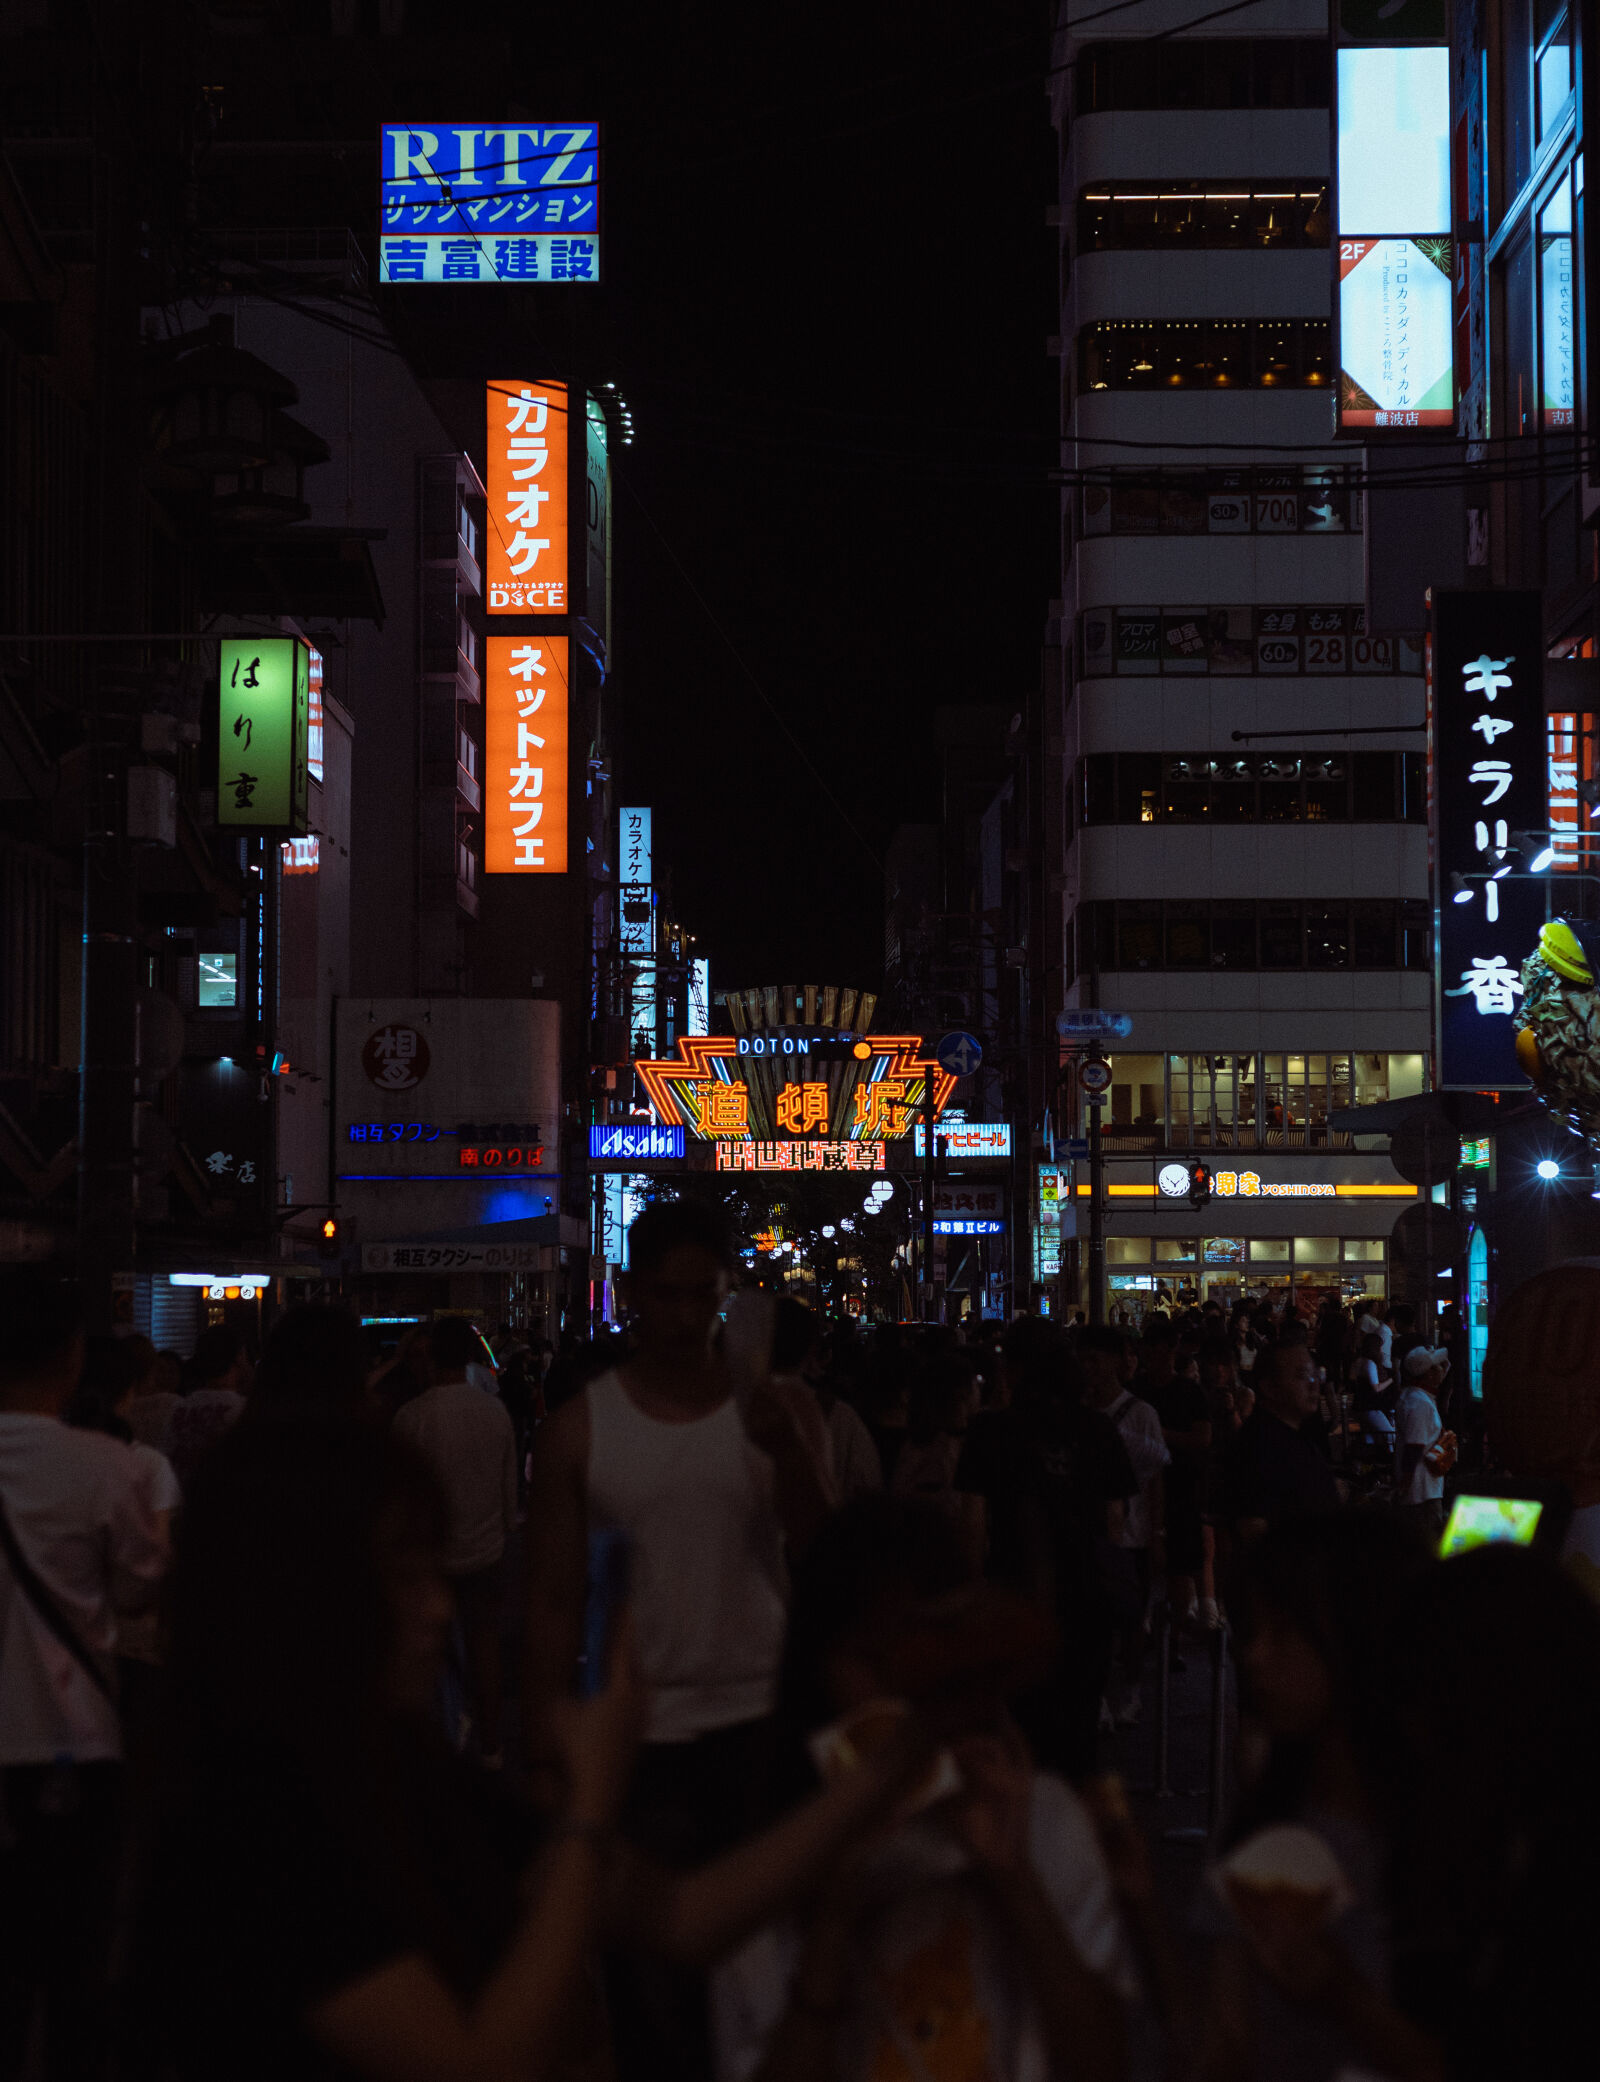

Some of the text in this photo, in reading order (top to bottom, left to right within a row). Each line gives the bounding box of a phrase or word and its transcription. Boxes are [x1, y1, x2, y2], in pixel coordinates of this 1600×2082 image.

[386, 129, 593, 186] RITZ
[387, 193, 593, 224] リッツマンション
[384, 238, 594, 281] 吉富建設
[1340, 243, 1366, 260] 2F
[1396, 243, 1411, 406] ココロカラダメディカル
[1374, 411, 1420, 427] 難波店
[505, 389, 550, 576] カラオケ
[1262, 612, 1297, 633] 全身
[224, 656, 261, 808] はり重
[508, 644, 547, 866] ネットカフェ
[697, 1080, 906, 1134] 道頓堀
[601, 1128, 674, 1155] Asahi
[458, 1146, 545, 1168] 南のりば
[1209, 1171, 1261, 1197] 野家
[1261, 1184, 1336, 1196] YOSHINOYA
[393, 1249, 534, 1268] 相互タクシーのりば
